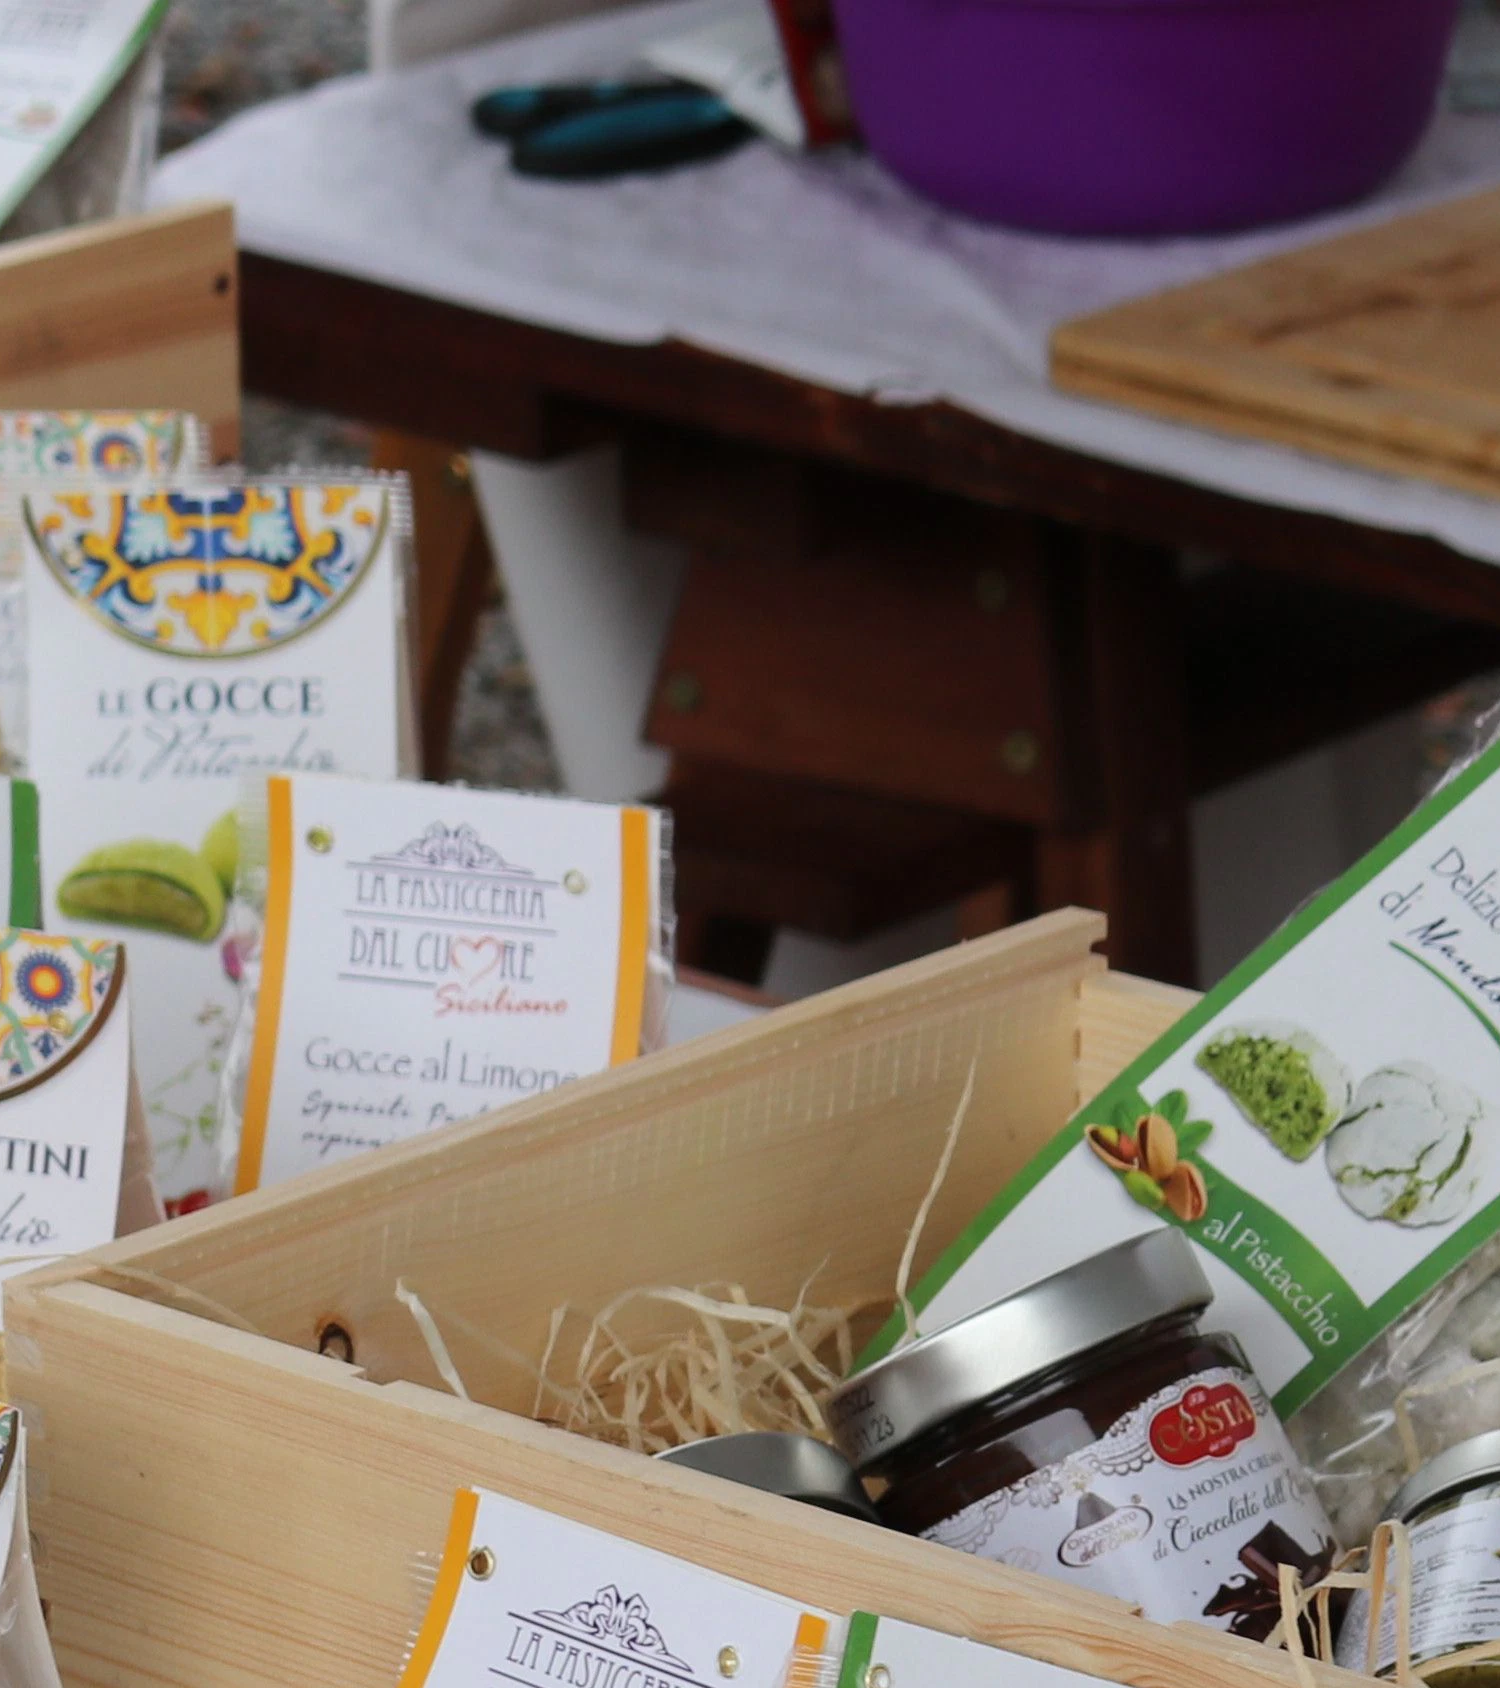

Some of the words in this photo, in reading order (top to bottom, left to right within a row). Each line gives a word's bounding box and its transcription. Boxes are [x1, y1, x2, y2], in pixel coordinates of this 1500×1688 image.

[145, 678, 325, 717] GOCCE
[354, 871, 387, 905] LA
[396, 875, 548, 921] PASTICCERIA
[1377, 884, 1413, 921] di
[349, 927, 406, 972] DAL
[303, 1036, 412, 1078] Gocce
[419, 1037, 451, 1081] al
[1202, 1209, 1234, 1244] al
[1232, 1226, 1341, 1350] Pistacchio
[1154, 1392, 1255, 1454] COSTA
[1166, 1491, 1188, 1511] LA
[1188, 1466, 1247, 1500] NOSTRA
[1151, 1539, 1170, 1562] di
[1168, 1492, 1261, 1543] Cioccolato
[505, 1625, 542, 1669] LA
